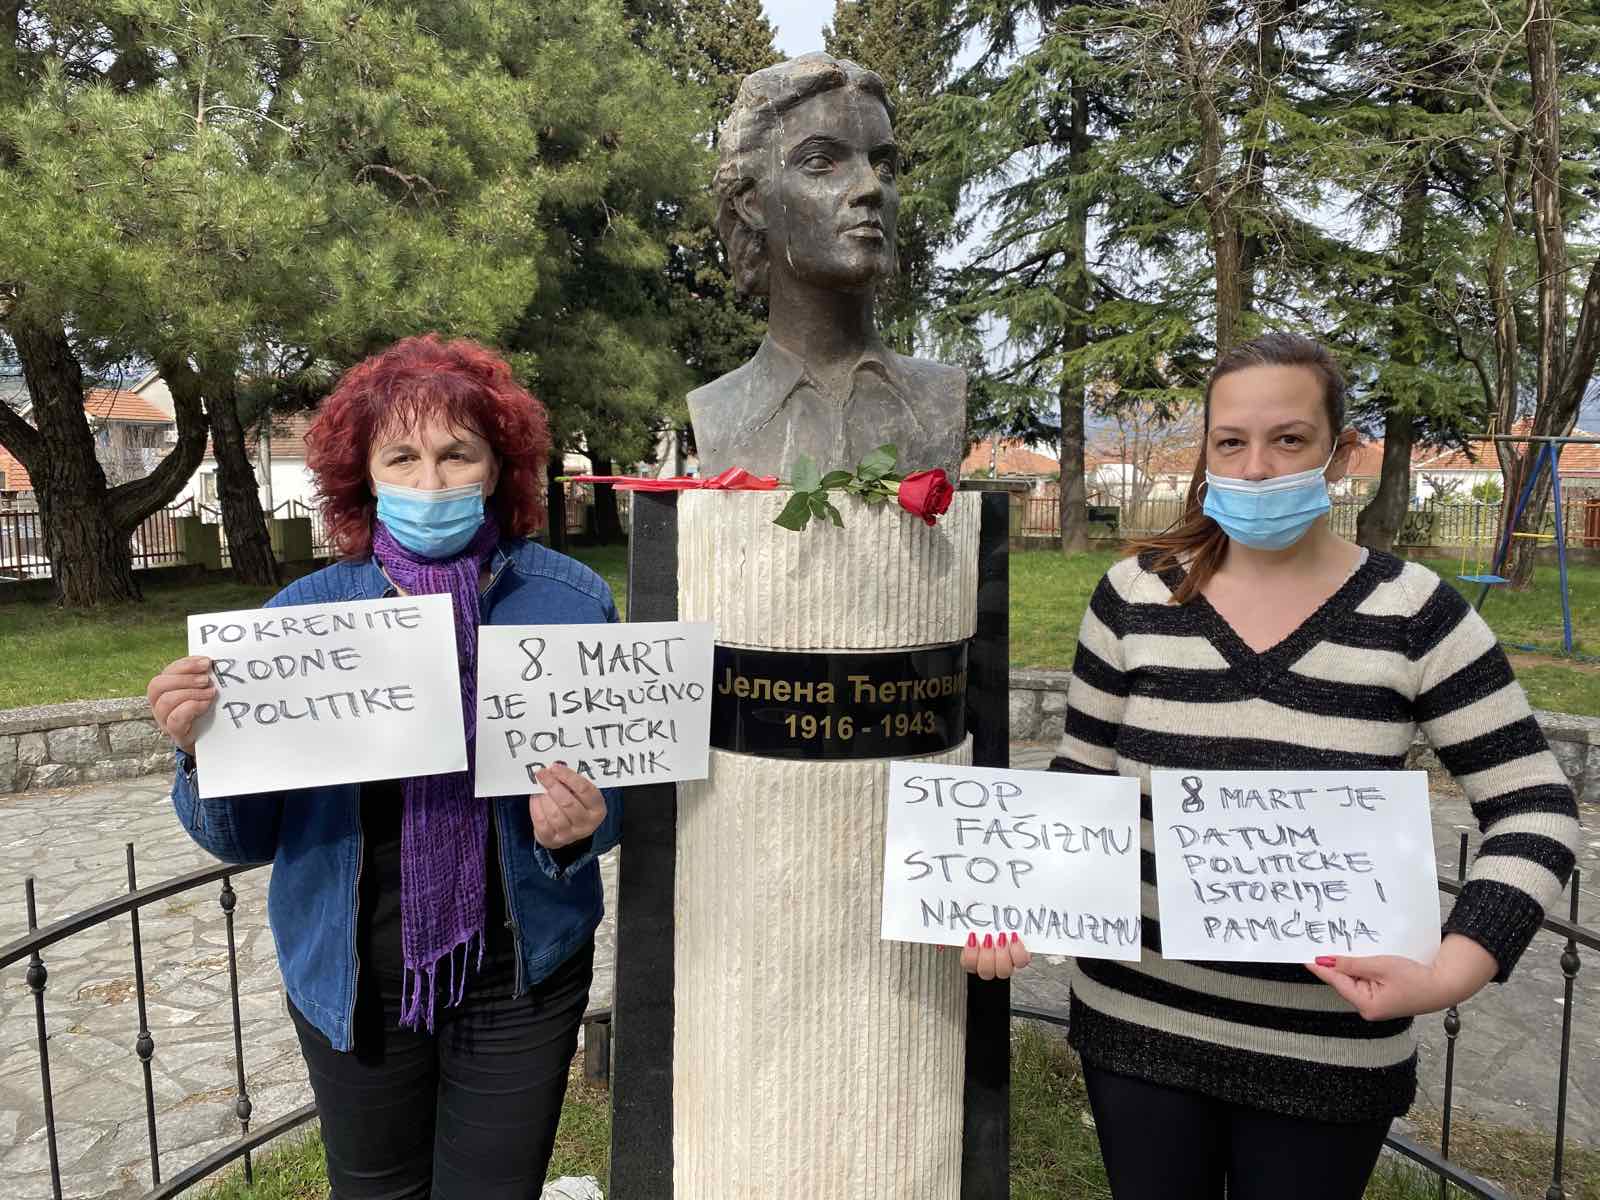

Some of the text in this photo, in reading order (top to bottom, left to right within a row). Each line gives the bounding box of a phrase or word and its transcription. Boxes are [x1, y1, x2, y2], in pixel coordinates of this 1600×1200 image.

[200, 606, 422, 645] POKRENITE
[210, 647, 361, 688] RODNE
[518, 636, 686, 681] 8. MART
[718, 667, 835, 704] Јелена
[223, 683, 415, 729] POLITIKE
[483, 693, 527, 720] JE
[505, 718, 678, 758] POLITIČKI
[785, 713, 854, 740] 1916
[880, 710, 937, 738] 1943
[525, 749, 671, 784] PAZNIK
[904, 776, 1023, 812] STOP
[1181, 776, 1386, 813] 8 MART JE
[954, 814, 1132, 856] FAŠIZMU
[1169, 824, 1321, 850] DATUM
[904, 851, 1033, 888] STOP
[1183, 850, 1375, 875] POLITIČKE
[1374, 879, 1387, 904] I
